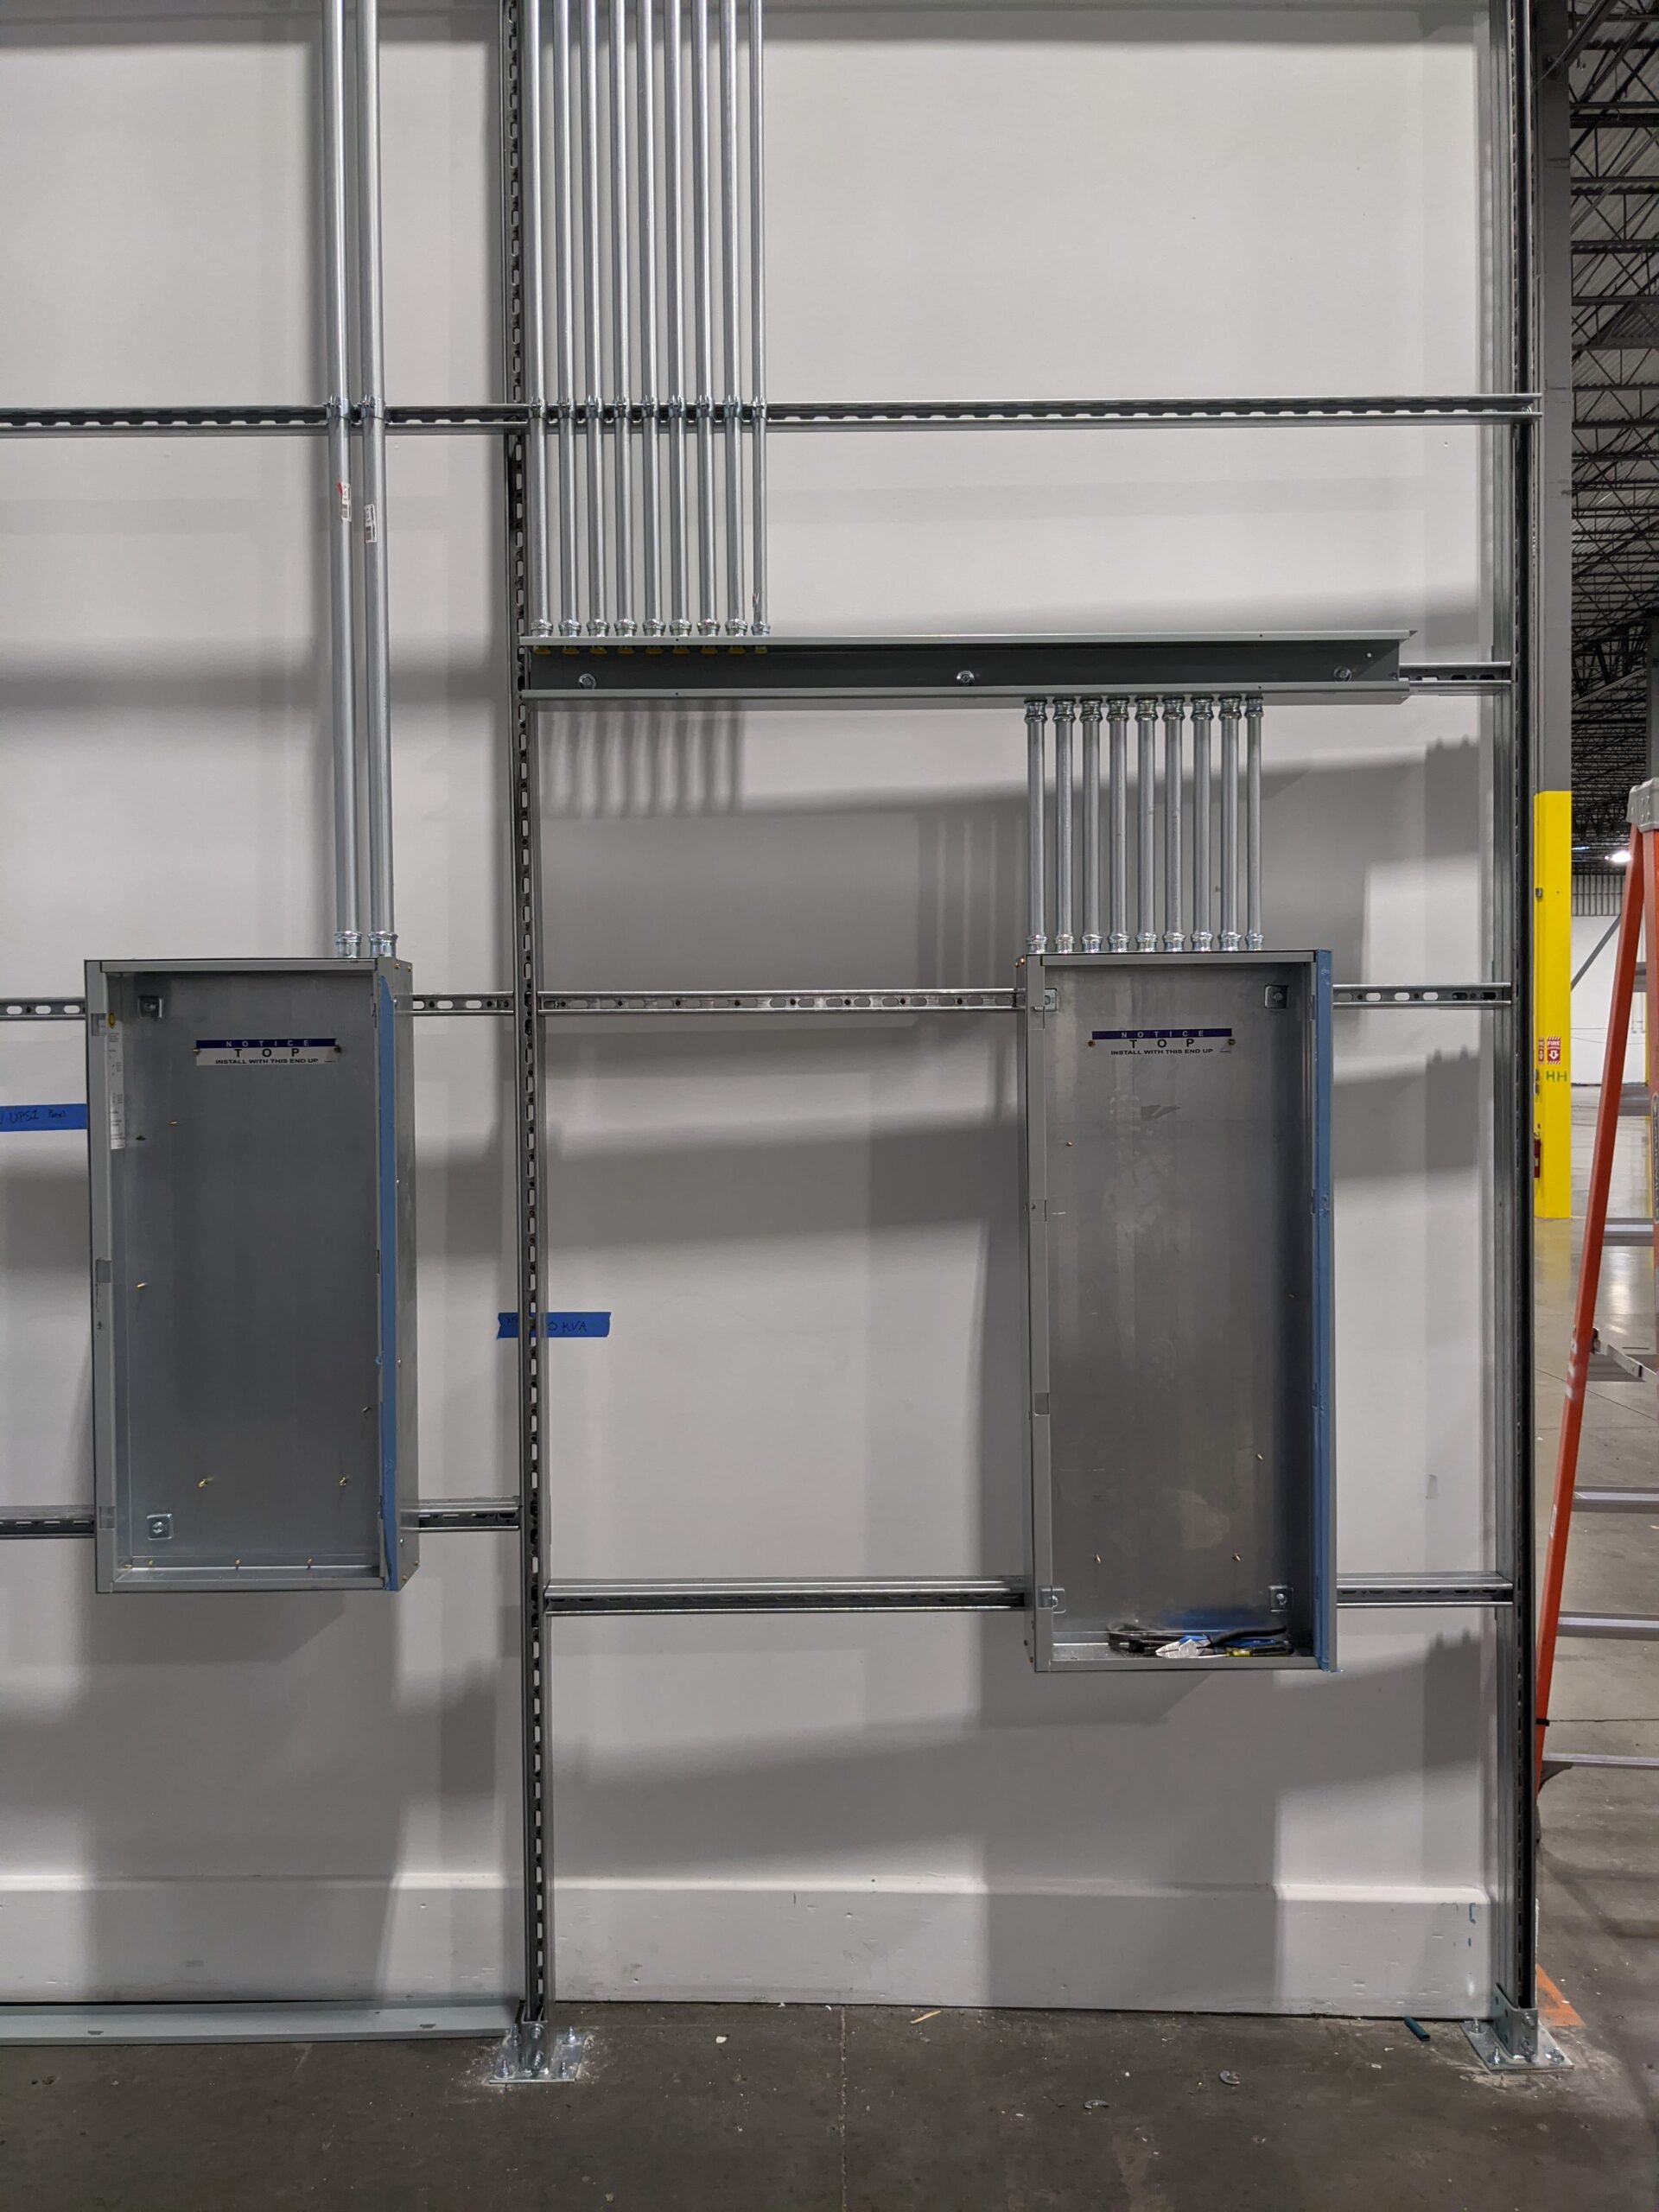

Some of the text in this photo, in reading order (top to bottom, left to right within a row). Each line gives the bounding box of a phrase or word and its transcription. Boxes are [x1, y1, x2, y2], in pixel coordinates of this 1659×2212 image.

[1122, 1030, 1205, 1039] NOTICE
[1129, 1039, 1195, 1048] TOP
[234, 1048, 301, 1058] TOP
